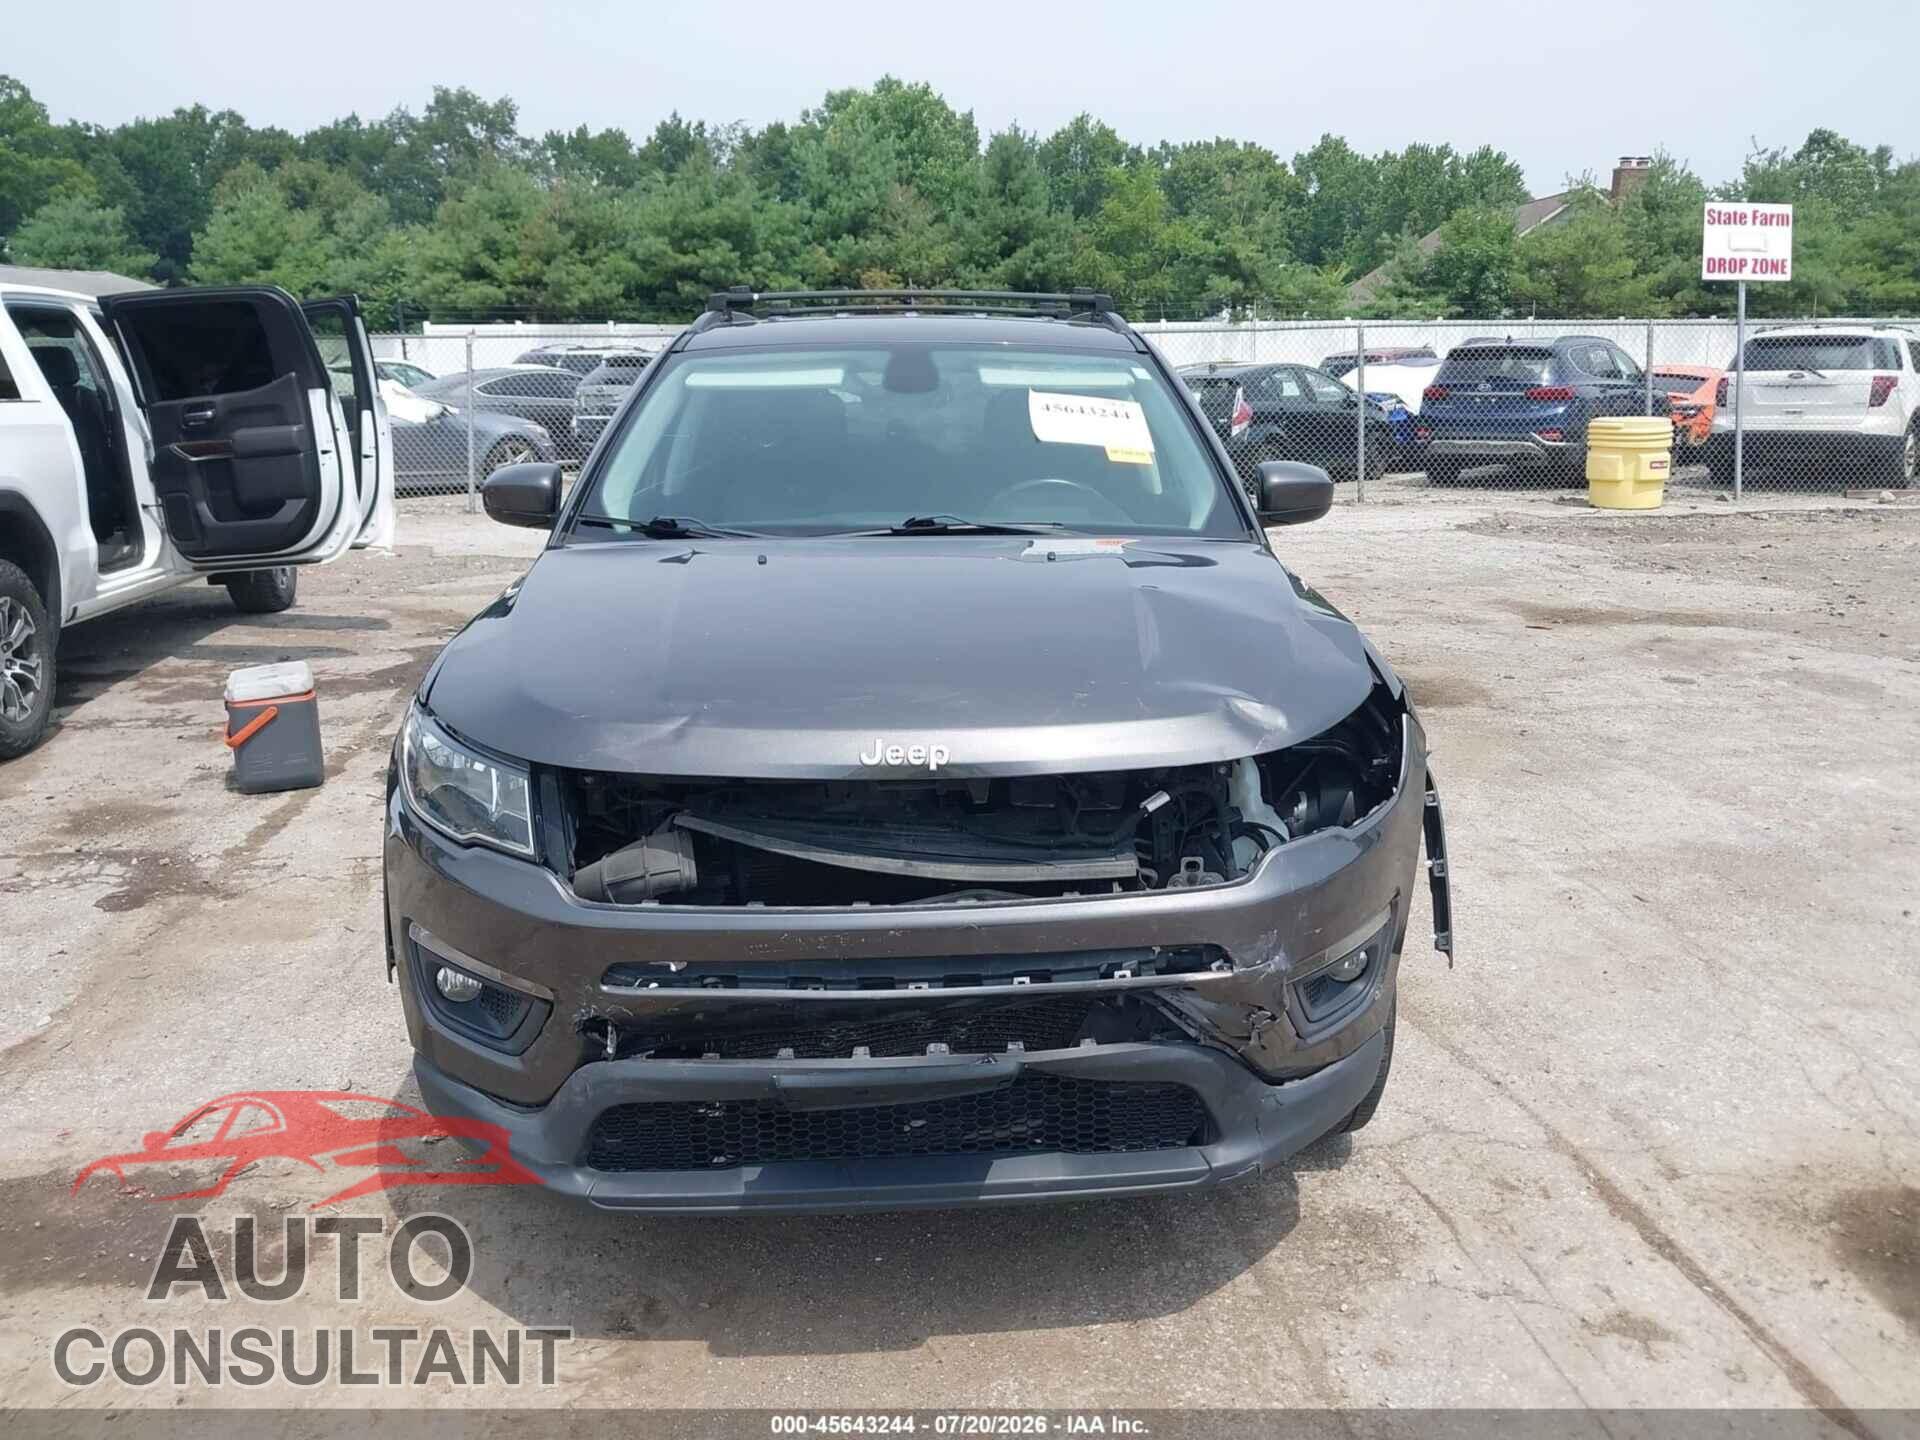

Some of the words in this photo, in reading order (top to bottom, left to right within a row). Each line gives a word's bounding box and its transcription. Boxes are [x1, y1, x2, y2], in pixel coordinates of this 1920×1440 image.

[1707, 208, 1747, 226] State
[1752, 208, 1790, 227] Farm
[1706, 256, 1748, 274] DROP
[1752, 257, 1788, 275] ZONE
[859, 738, 951, 771] Jeep
